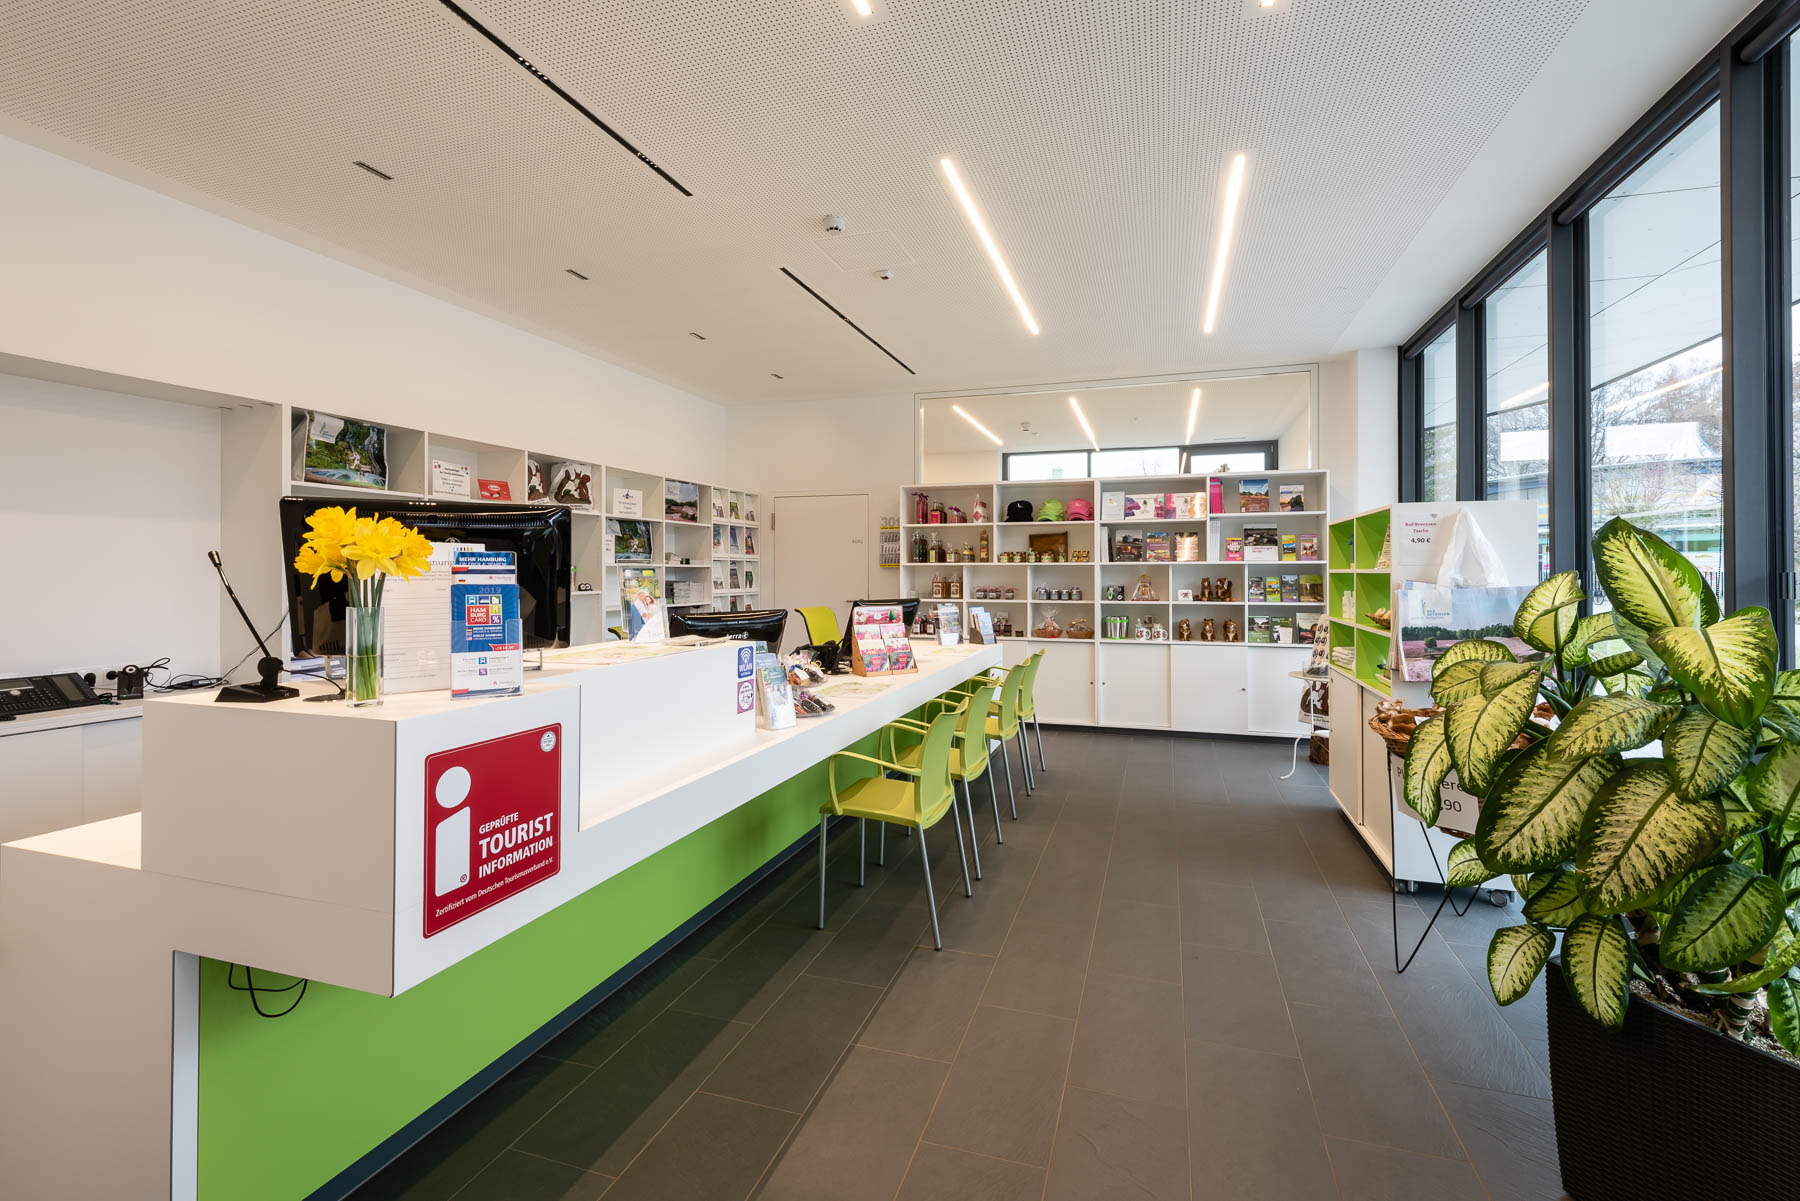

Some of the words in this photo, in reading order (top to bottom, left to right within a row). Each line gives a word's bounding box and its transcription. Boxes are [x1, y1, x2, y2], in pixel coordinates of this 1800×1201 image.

[739, 662, 752, 672] WLAN
[479, 812, 519, 834] GEPRÜFTE
[479, 812, 554, 859] TOURIST
[479, 836, 553, 878] INFORMATION
[435, 898, 464, 918] Zertifiziert
[465, 892, 477, 903] vom
[478, 879, 504, 898] Deutschen
[504, 861, 546, 884] Tourismusverband
